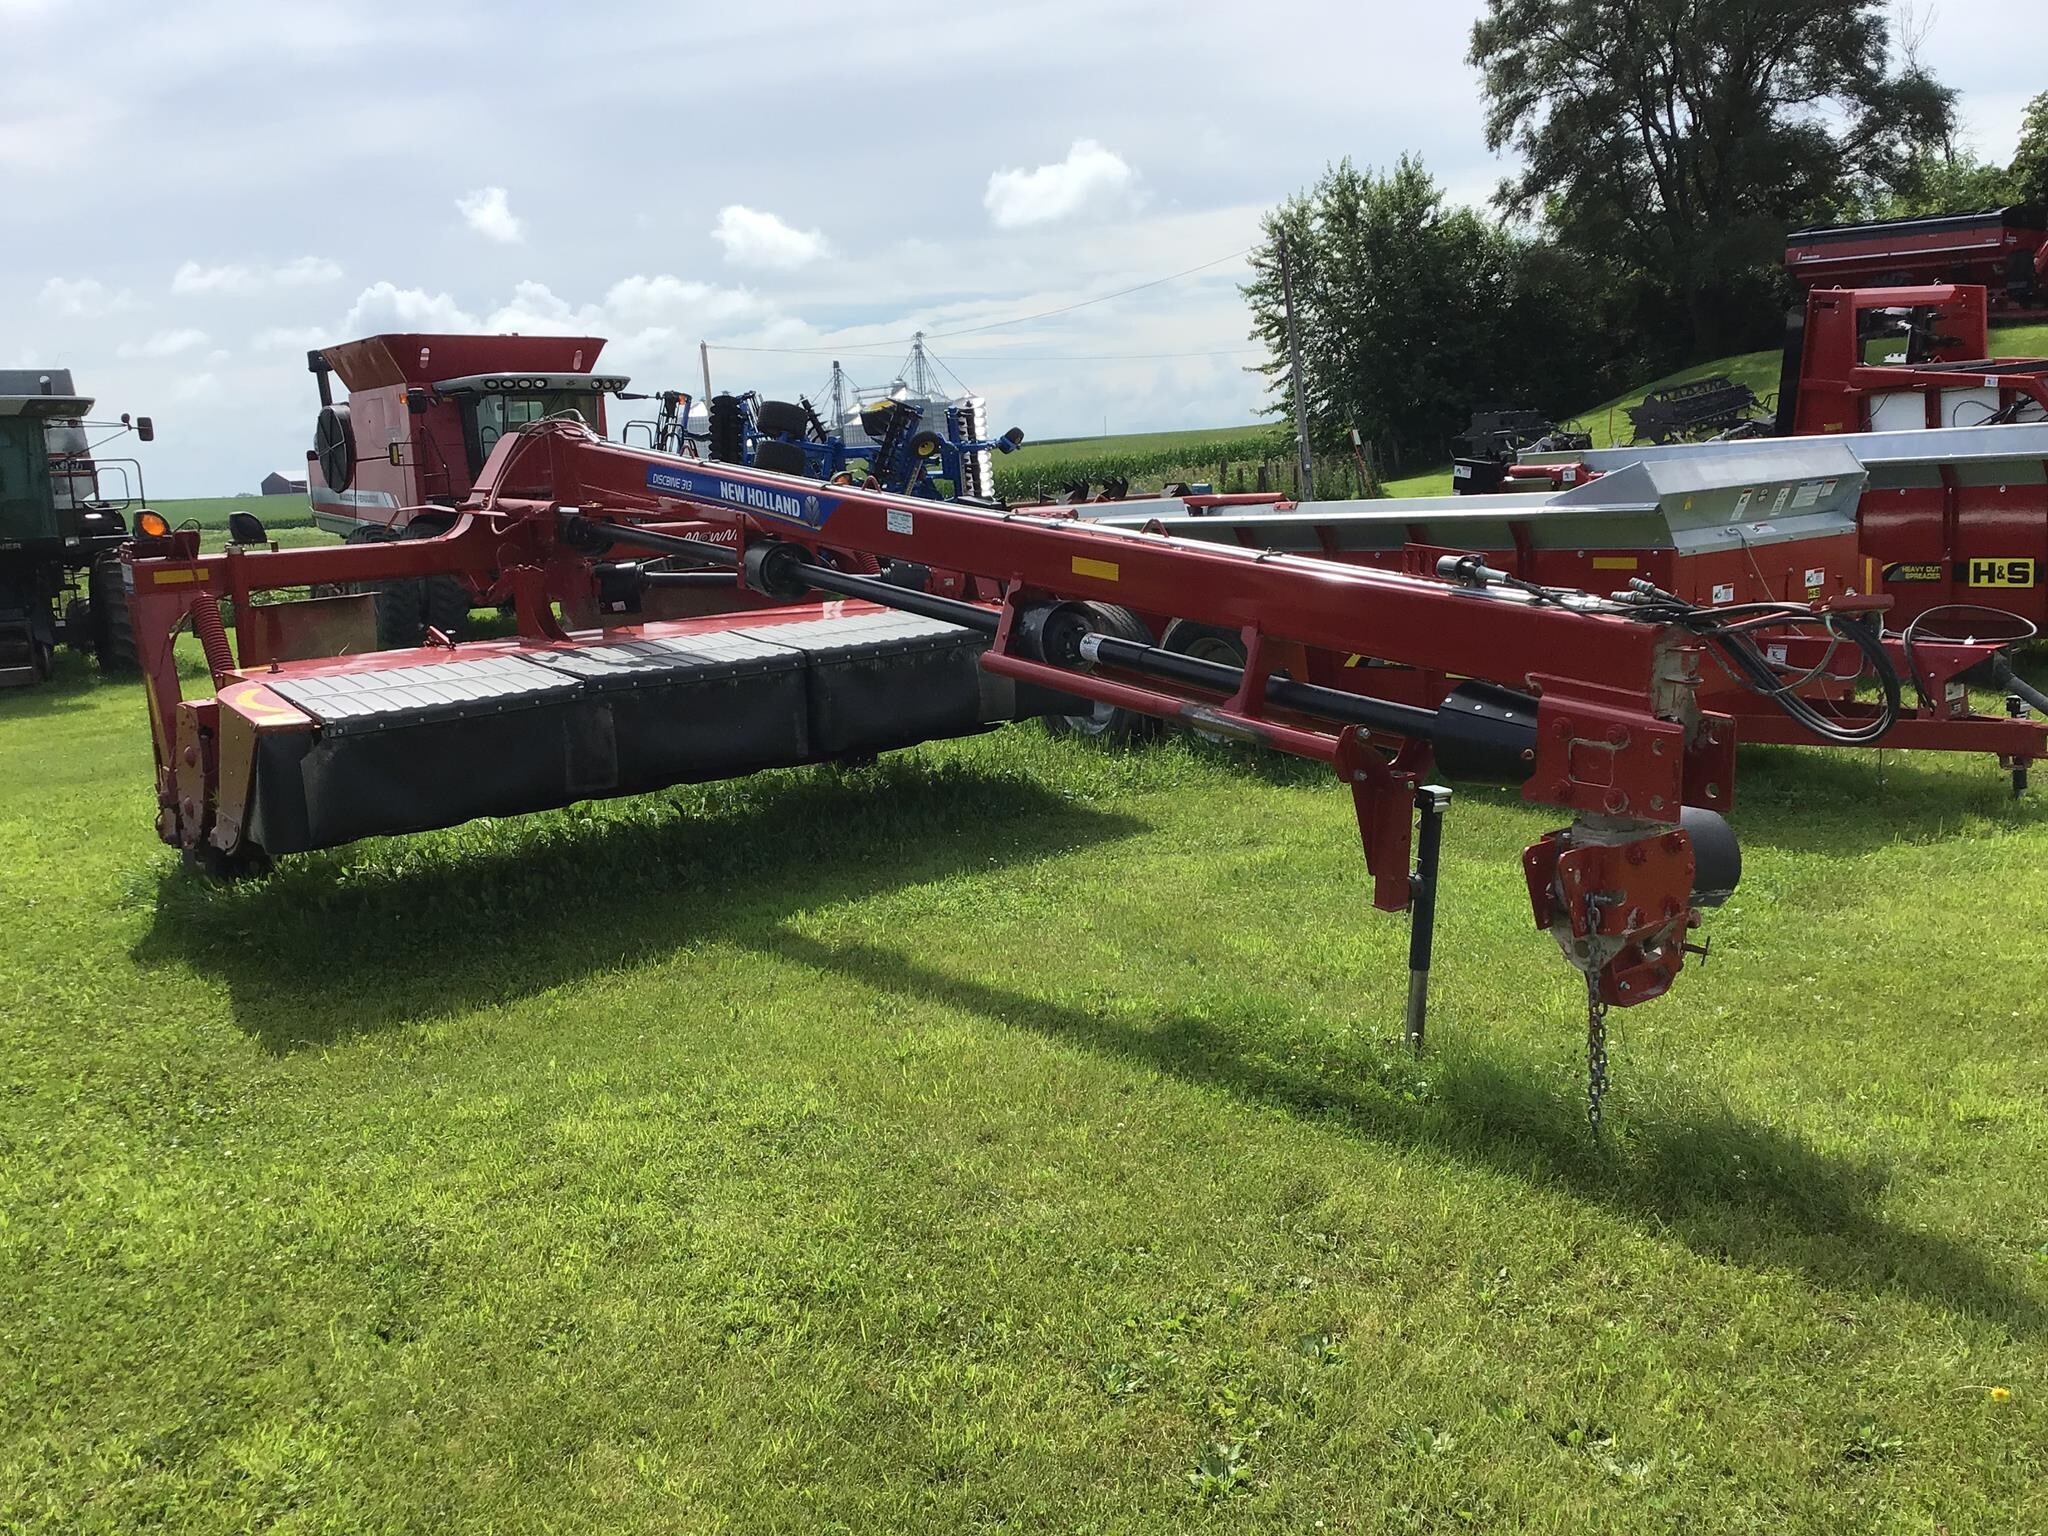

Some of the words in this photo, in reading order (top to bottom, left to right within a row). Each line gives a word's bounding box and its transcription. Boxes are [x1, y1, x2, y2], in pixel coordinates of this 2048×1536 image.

[652, 473, 681, 488] DISCBINE
[681, 479, 693, 491] 313
[720, 481, 745, 503] NEW
[747, 487, 800, 517] HOLLAND
[1902, 565, 1925, 573] HEAVY
[1904, 572, 1941, 580] SPREADER
[1973, 562, 2031, 584] H&S
